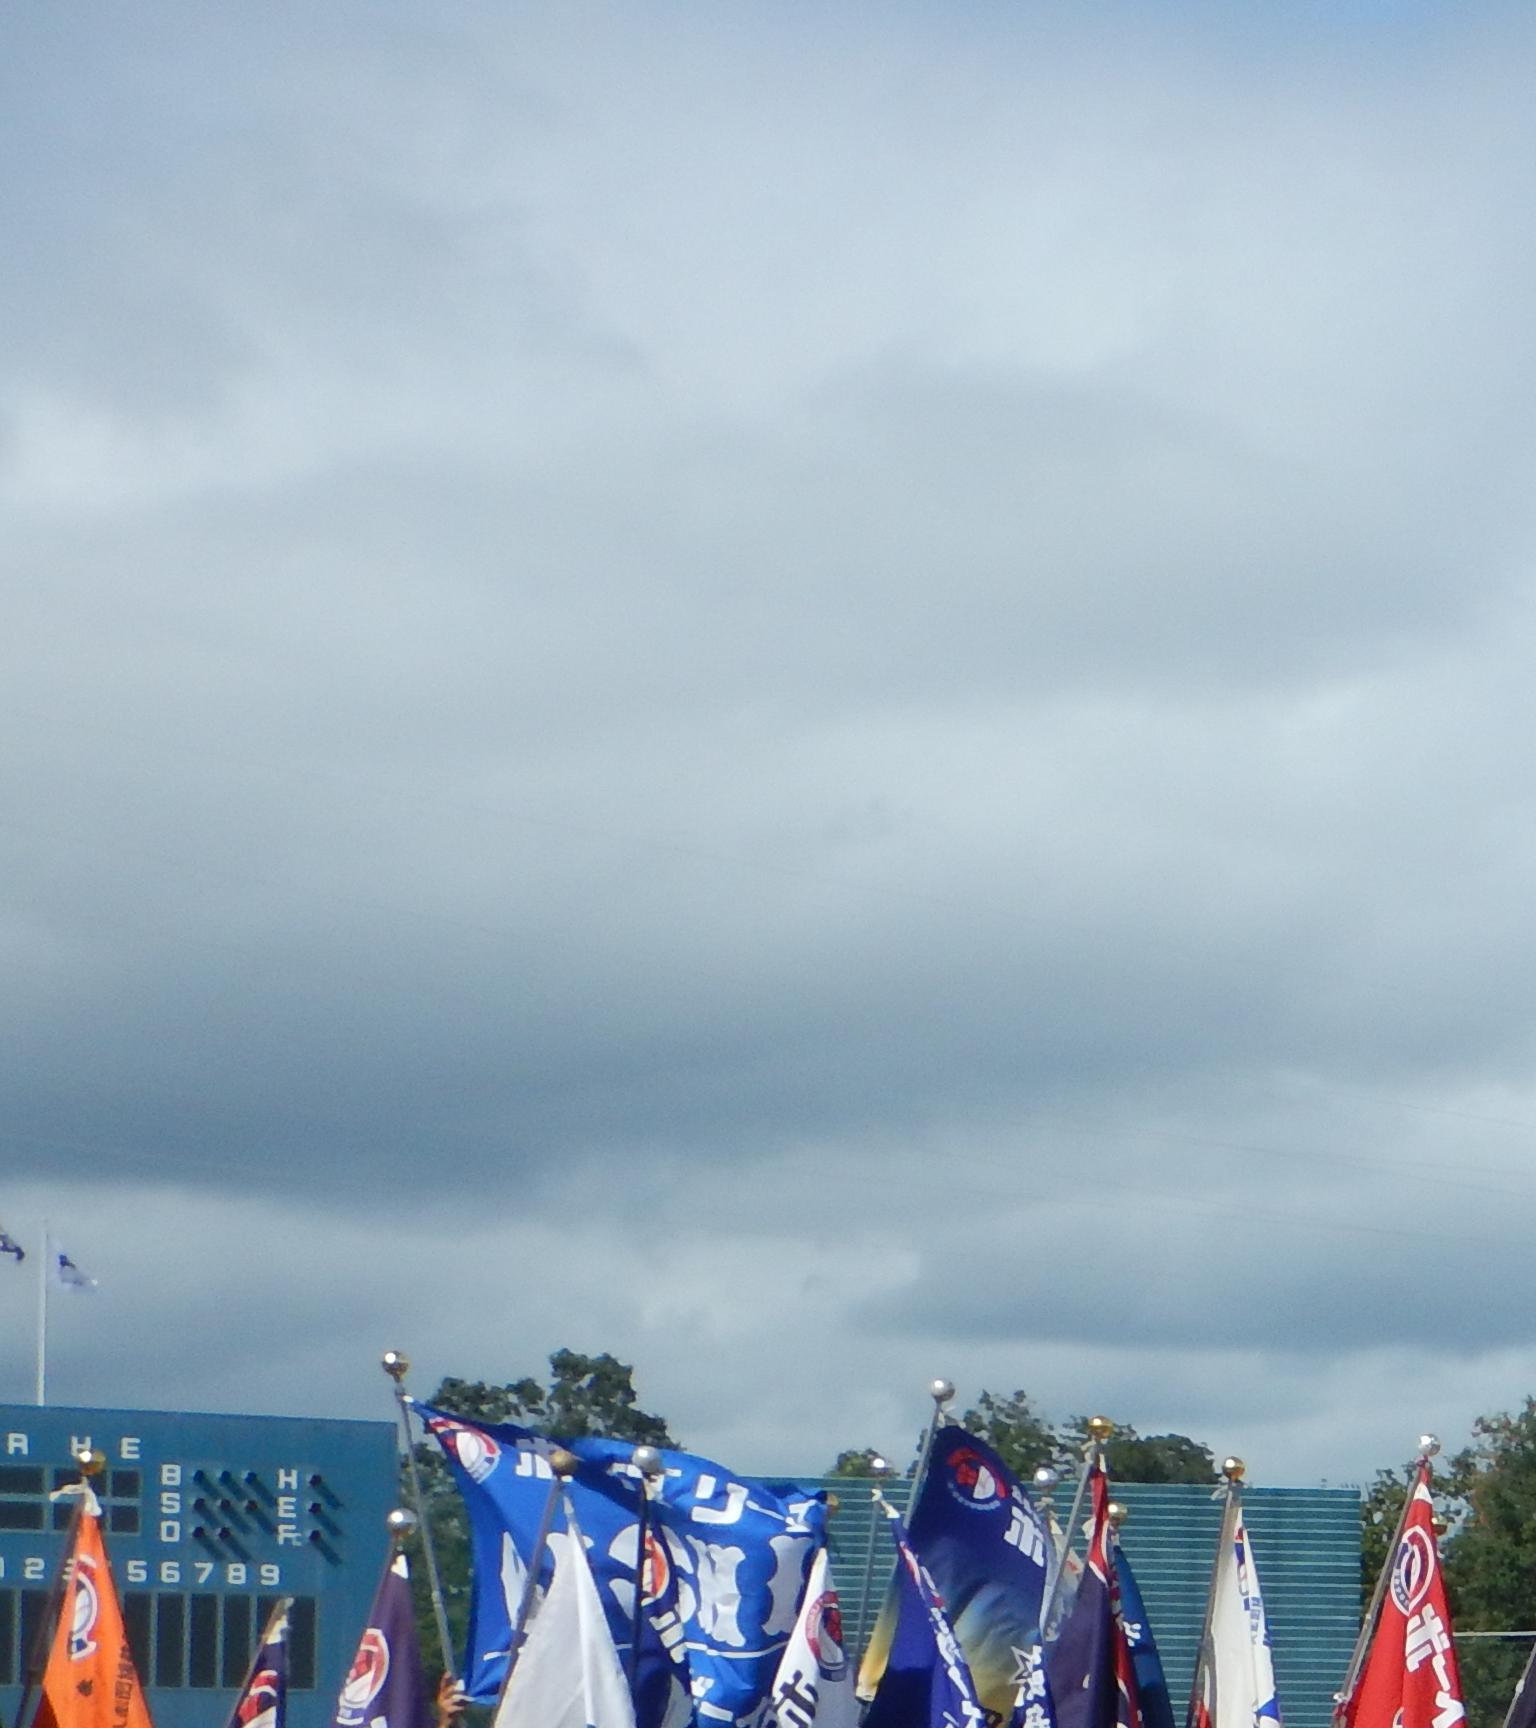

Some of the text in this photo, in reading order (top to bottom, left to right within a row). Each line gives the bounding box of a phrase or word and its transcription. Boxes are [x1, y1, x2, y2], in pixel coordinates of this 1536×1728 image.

[120, 1436, 141, 1460] E
[160, 1463, 182, 1486] B
[278, 1467, 298, 1490] H
[160, 1492, 181, 1515] S
[277, 1496, 297, 1519] E
[24, 1557, 46, 1580] 2
[127, 1560, 148, 1583] 5
[160, 1561, 181, 1584] 6
[194, 1562, 214, 1585] 7
[227, 1563, 247, 1586] 8
[260, 1564, 280, 1587] 9
